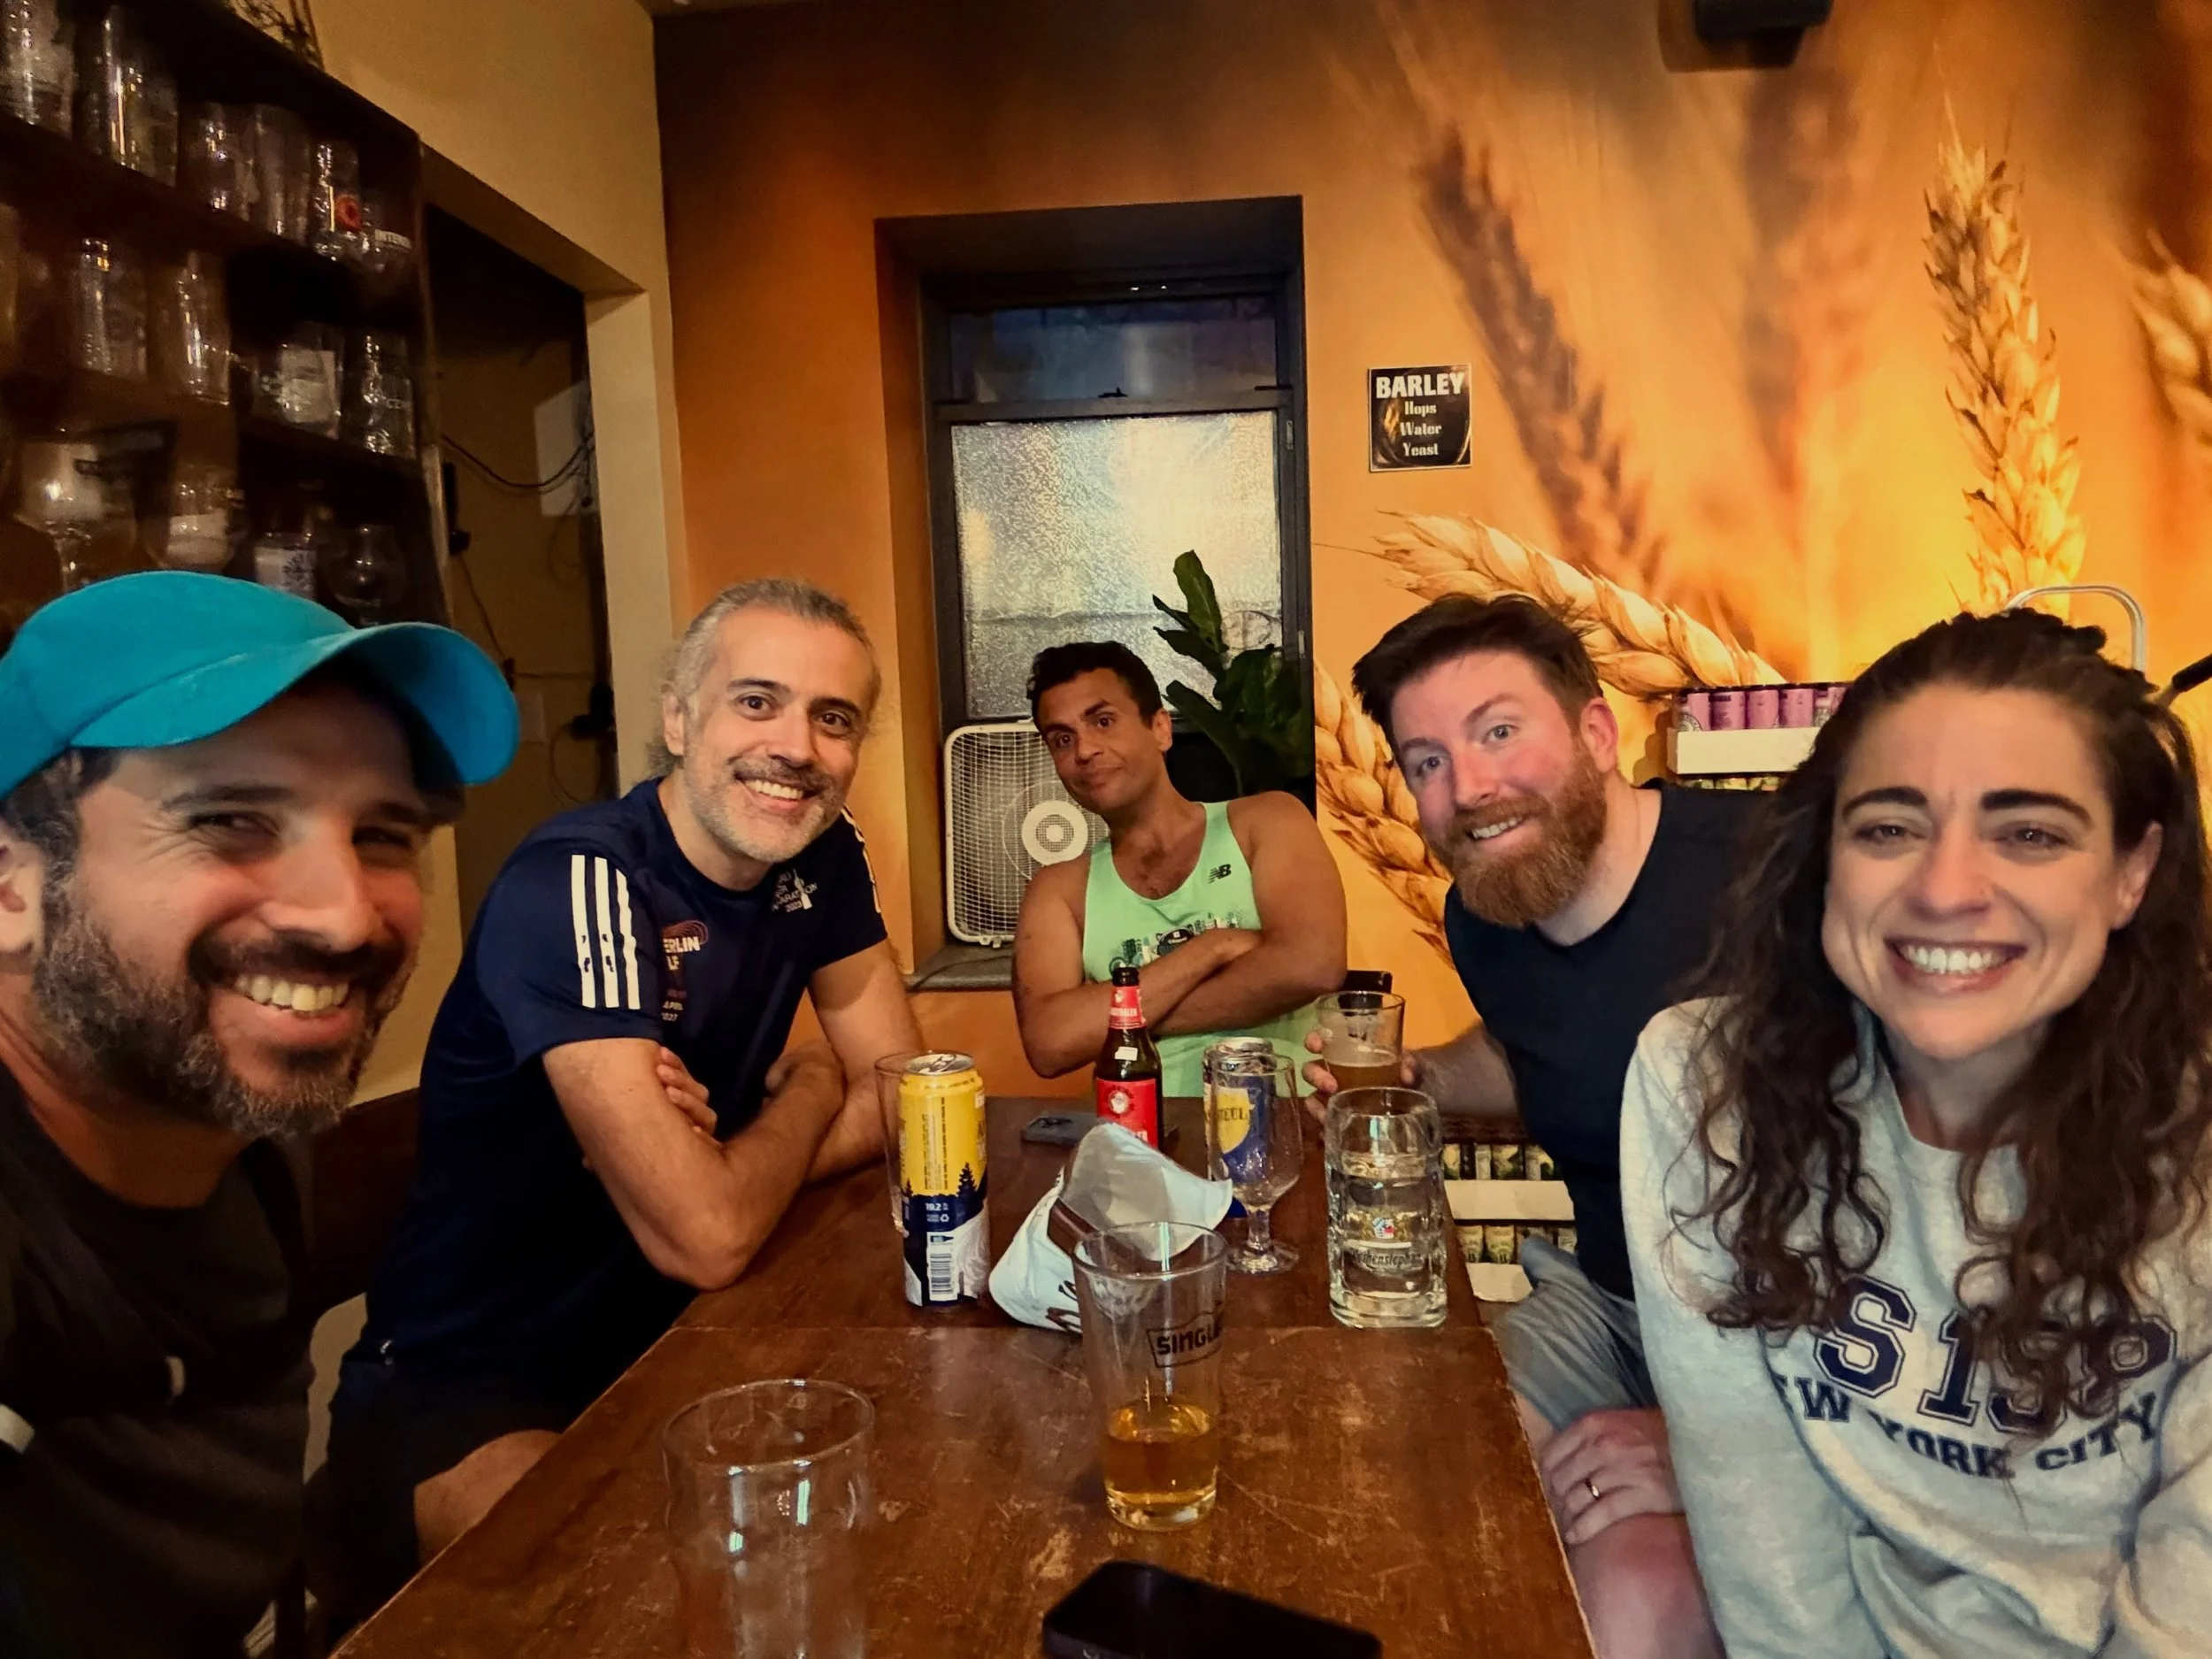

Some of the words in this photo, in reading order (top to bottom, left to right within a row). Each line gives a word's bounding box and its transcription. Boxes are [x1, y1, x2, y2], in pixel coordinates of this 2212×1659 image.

[1376, 372, 1465, 398] BARLEY
[1404, 401, 1437, 417] Hops
[1400, 422, 1442, 436] Water
[1402, 442, 1439, 457] Yeast
[1865, 1409, 2016, 1479] YORK
[2035, 1391, 2159, 1471] CITY
